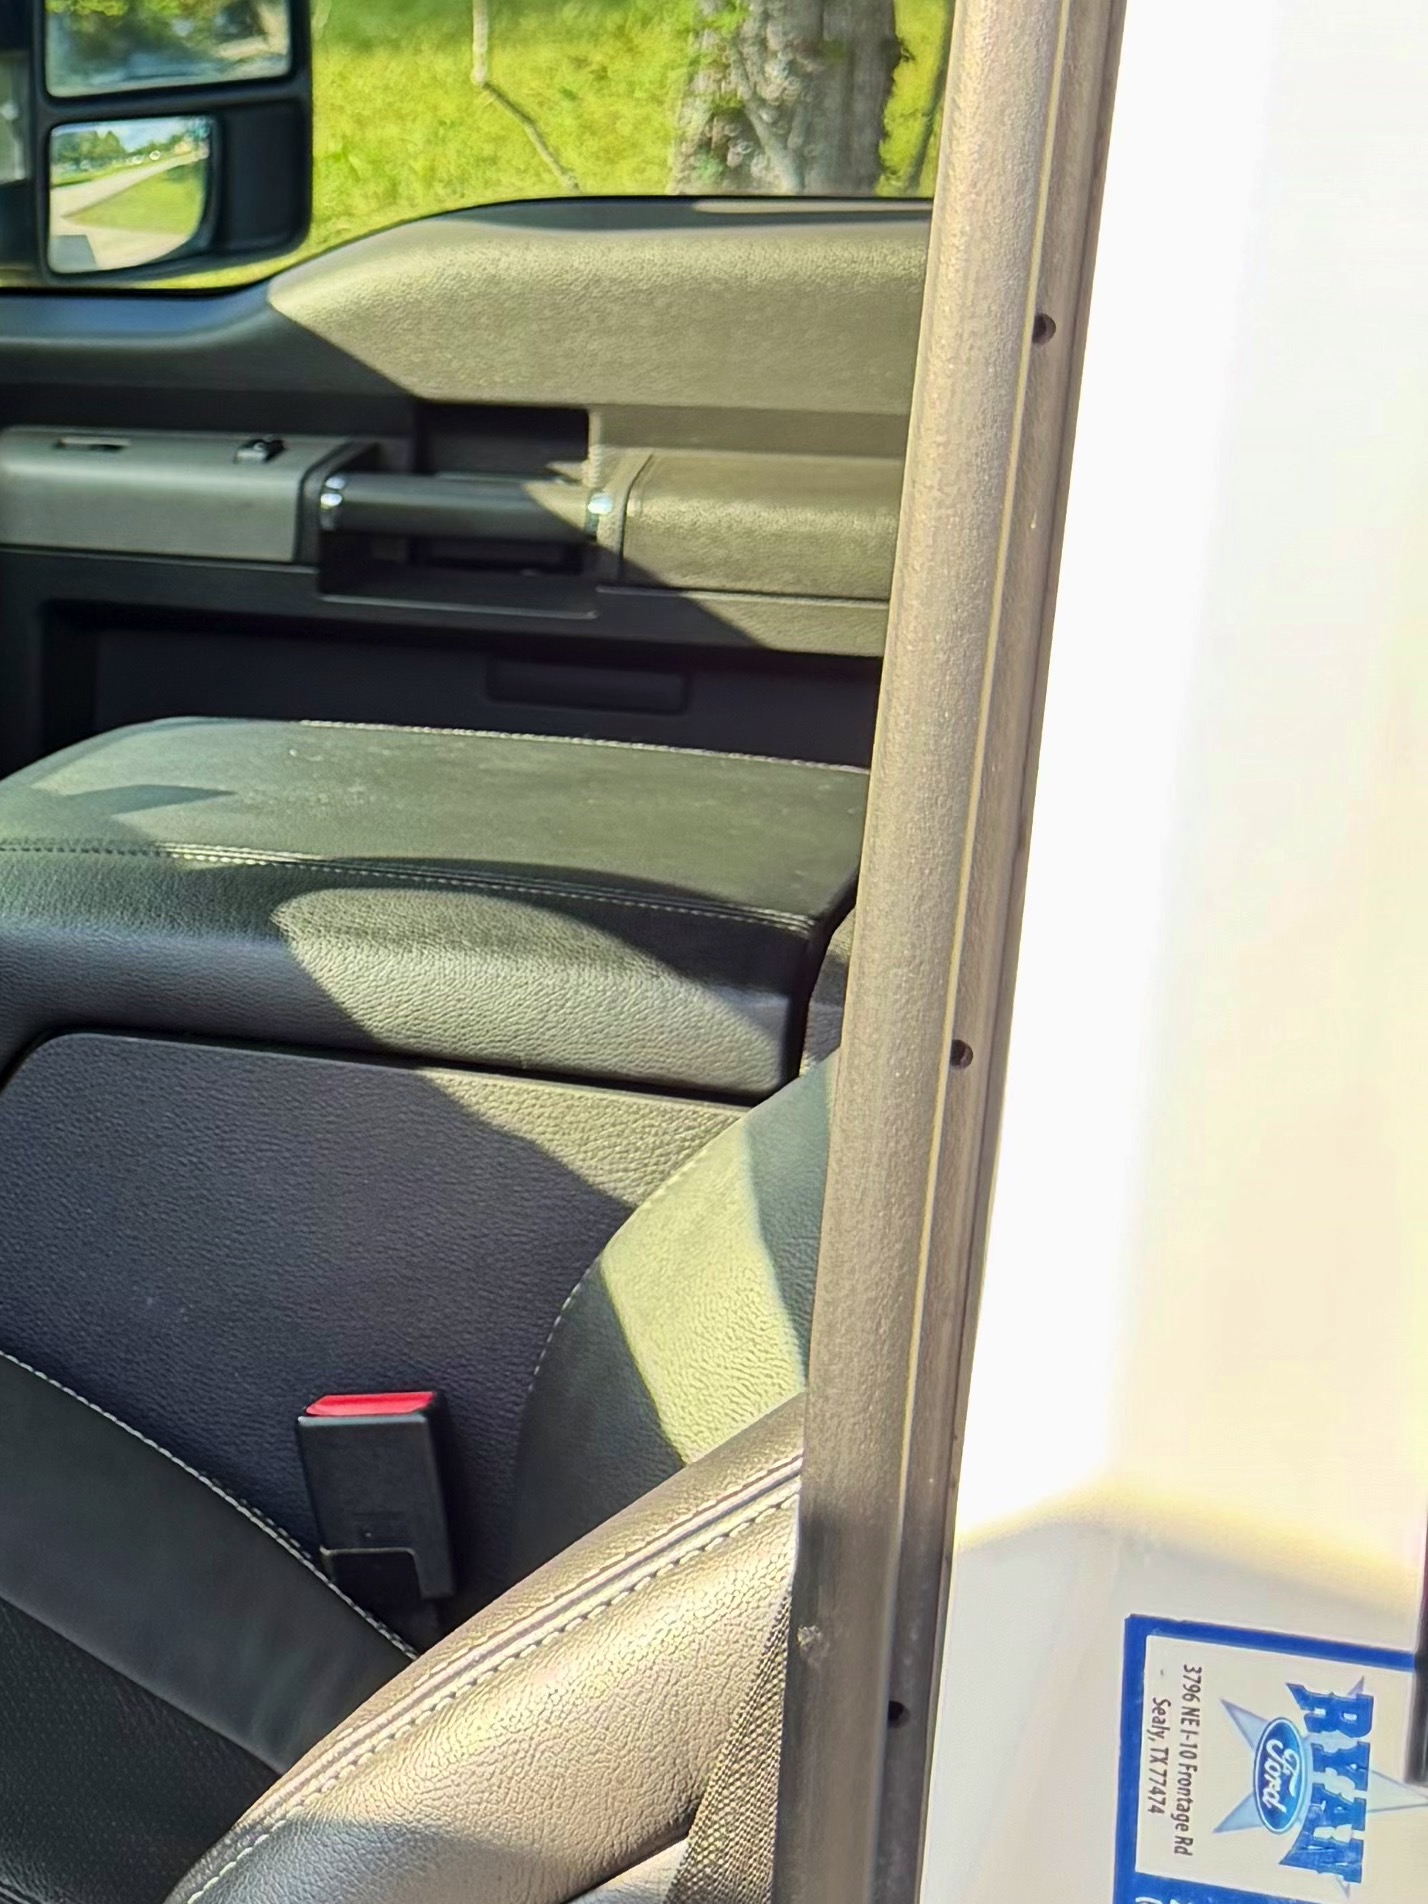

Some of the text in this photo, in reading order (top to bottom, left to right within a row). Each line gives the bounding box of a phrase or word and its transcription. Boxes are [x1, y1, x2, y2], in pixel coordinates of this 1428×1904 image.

[1180, 1706, 1199, 1727] NE
[1182, 1664, 1202, 1701] 3796
[1147, 1697, 1171, 1814] Sealy, TX 77474
[1265, 1740, 1304, 1820] Ford
[1278, 1682, 1374, 1884] RYAN
[1171, 1763, 1197, 1832] Frontage
[1172, 1836, 1193, 1856] Rd
